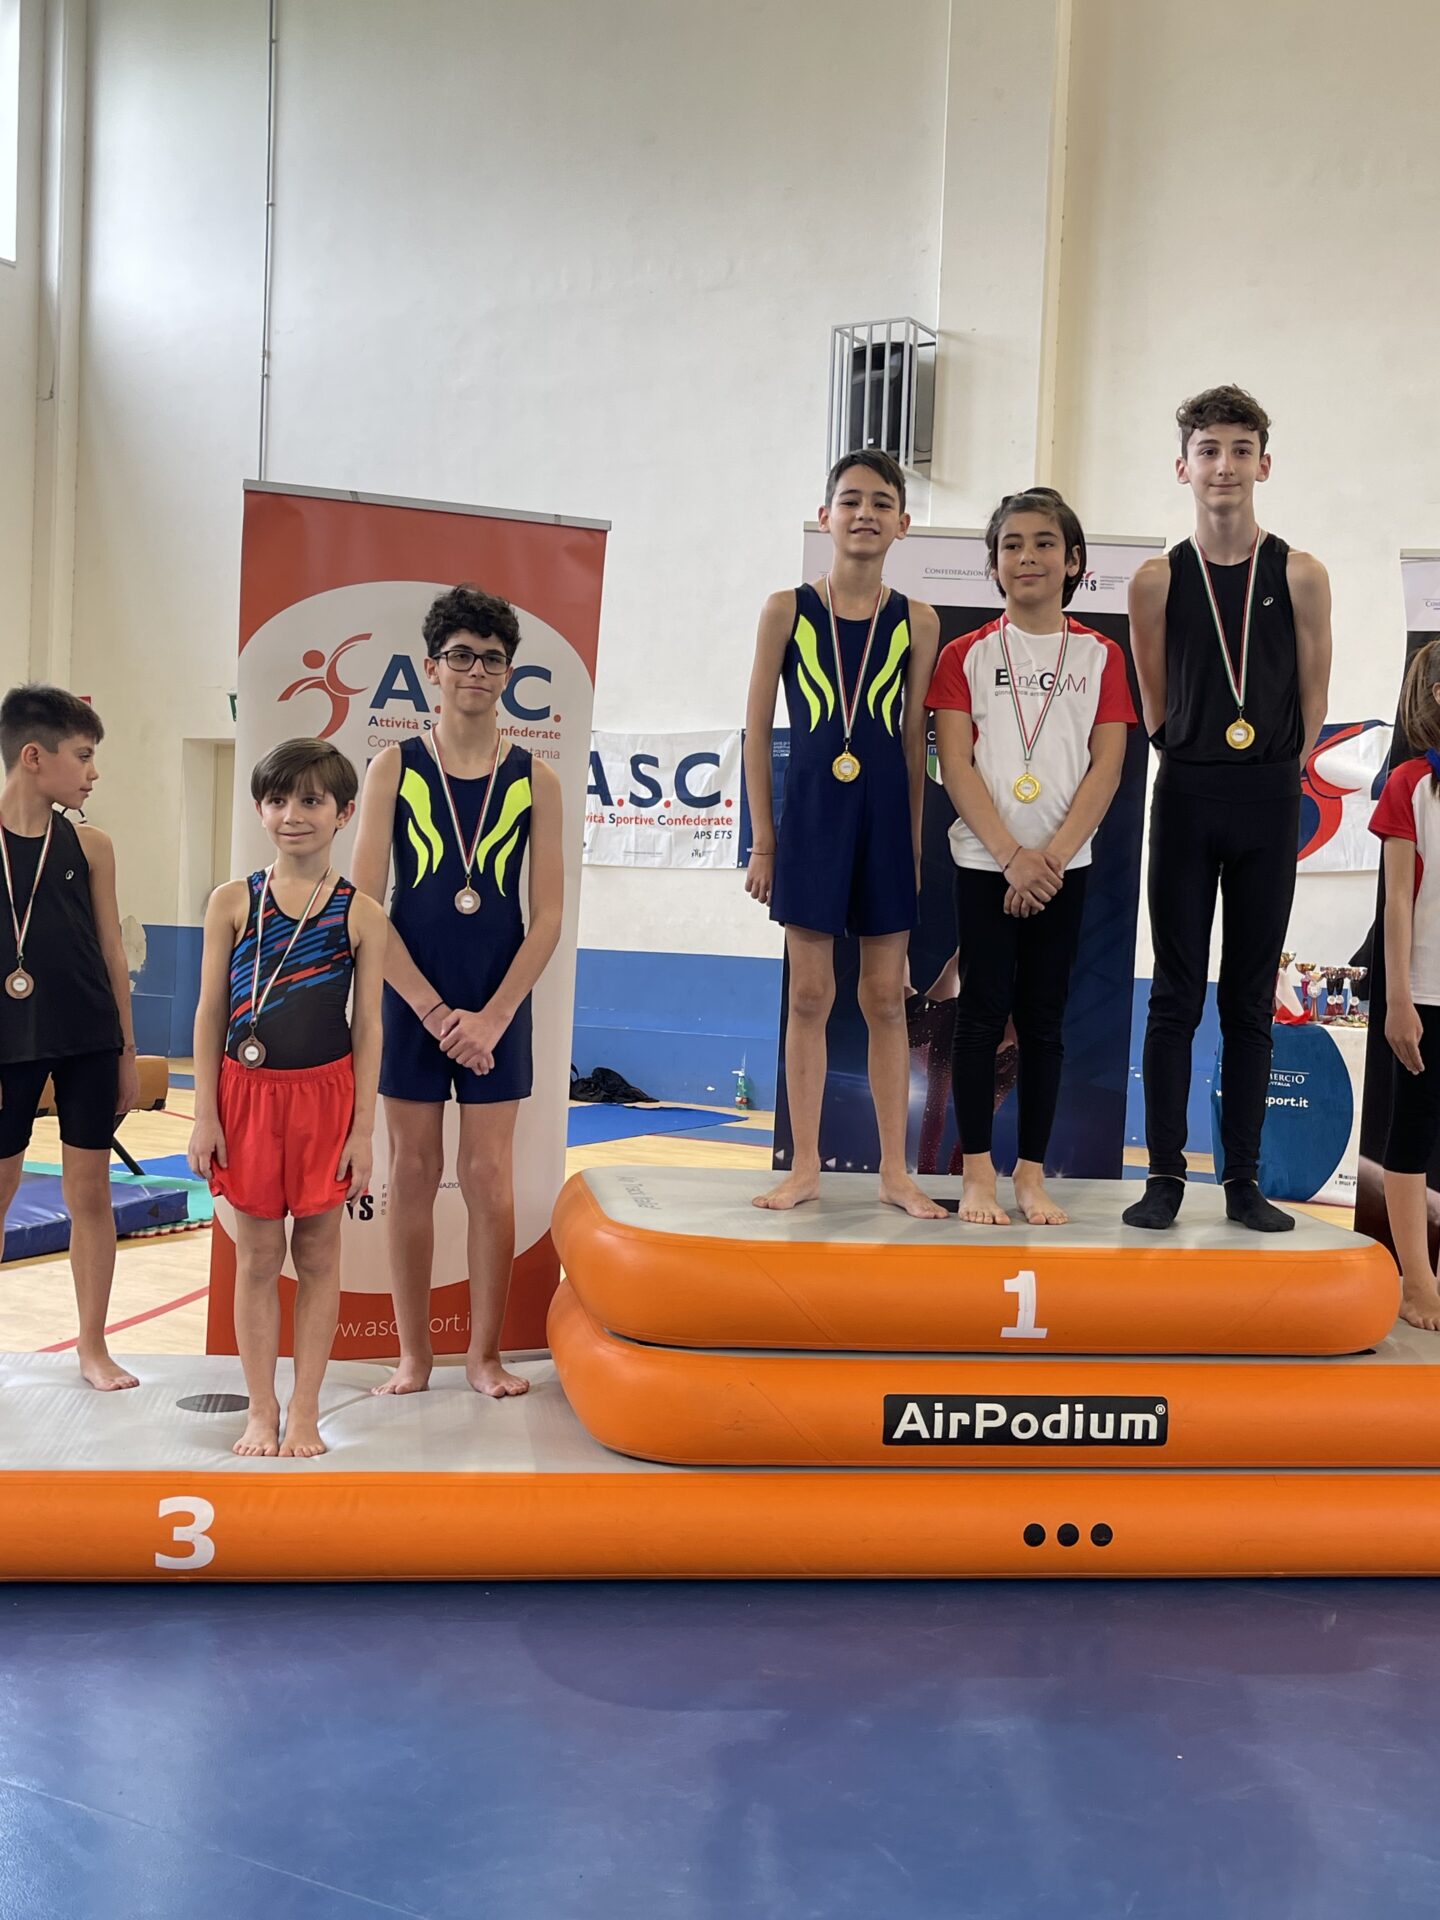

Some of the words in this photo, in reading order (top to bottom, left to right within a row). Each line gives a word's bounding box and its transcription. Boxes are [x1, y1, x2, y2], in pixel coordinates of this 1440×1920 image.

[368, 715, 420, 730] Attività
[497, 726, 562, 740] nfederate
[586, 751, 733, 809] A.S.C.
[608, 813, 655, 828] Sportive
[657, 814, 733, 827] Confederate
[693, 830, 713, 840] APS
[714, 830, 733, 840] ETS
[1000, 1270, 1048, 1339] 1
[155, 1496, 215, 1569] 3
